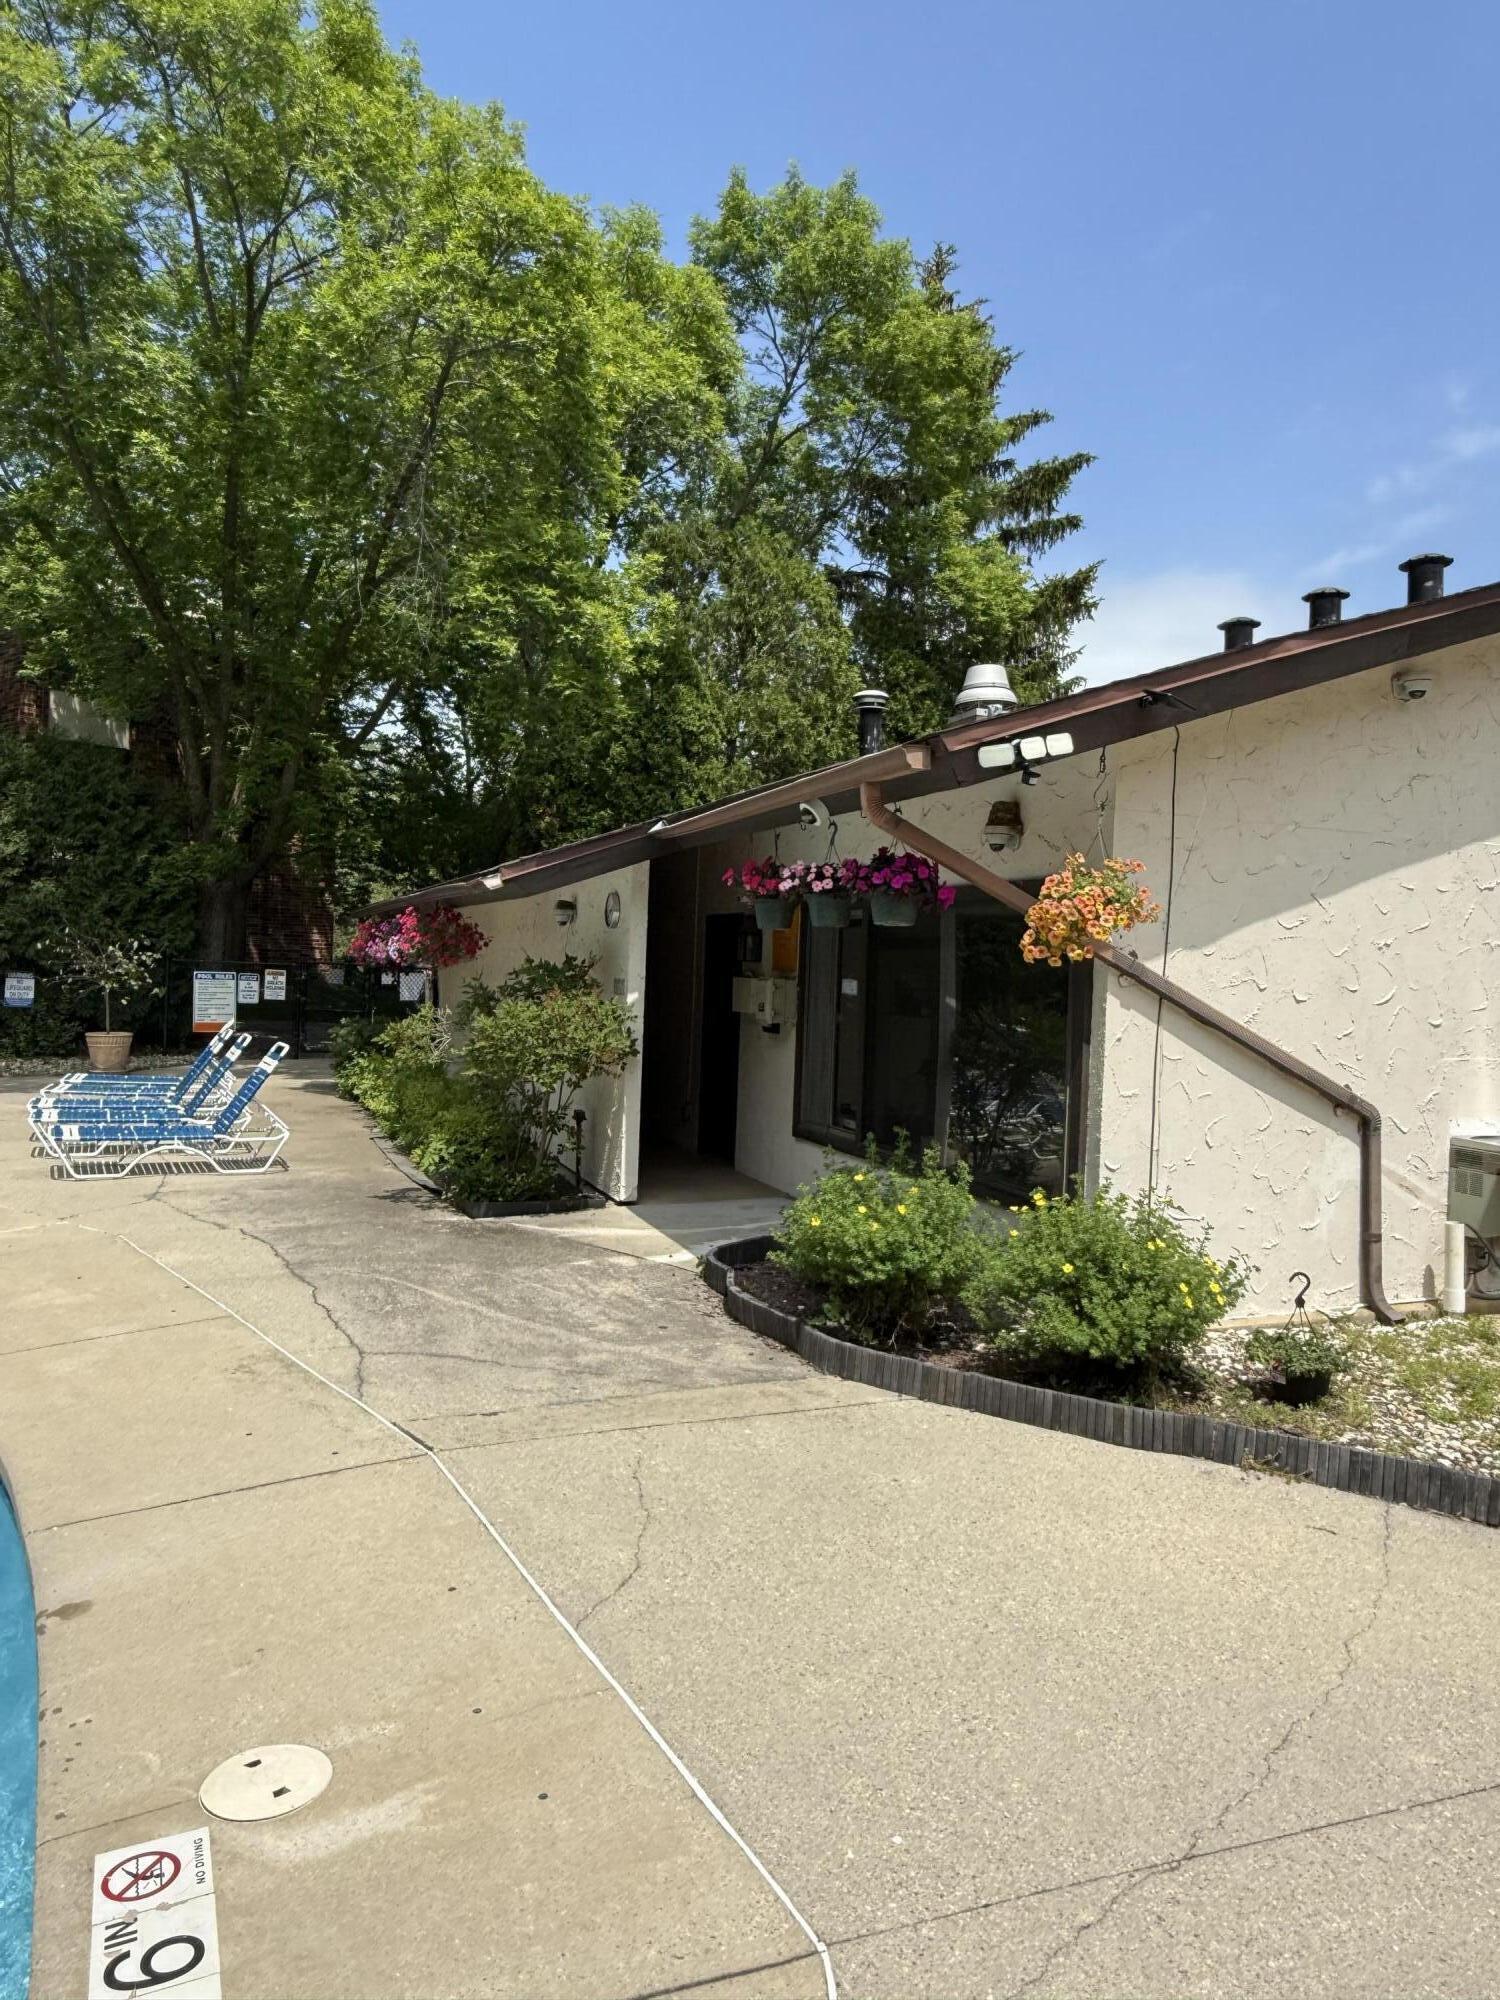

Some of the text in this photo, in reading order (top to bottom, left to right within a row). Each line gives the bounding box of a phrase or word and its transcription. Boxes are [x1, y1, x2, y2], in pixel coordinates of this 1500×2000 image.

[193, 1837, 206, 1885] NO DIVING
[103, 1917, 206, 1991] 6 IN
